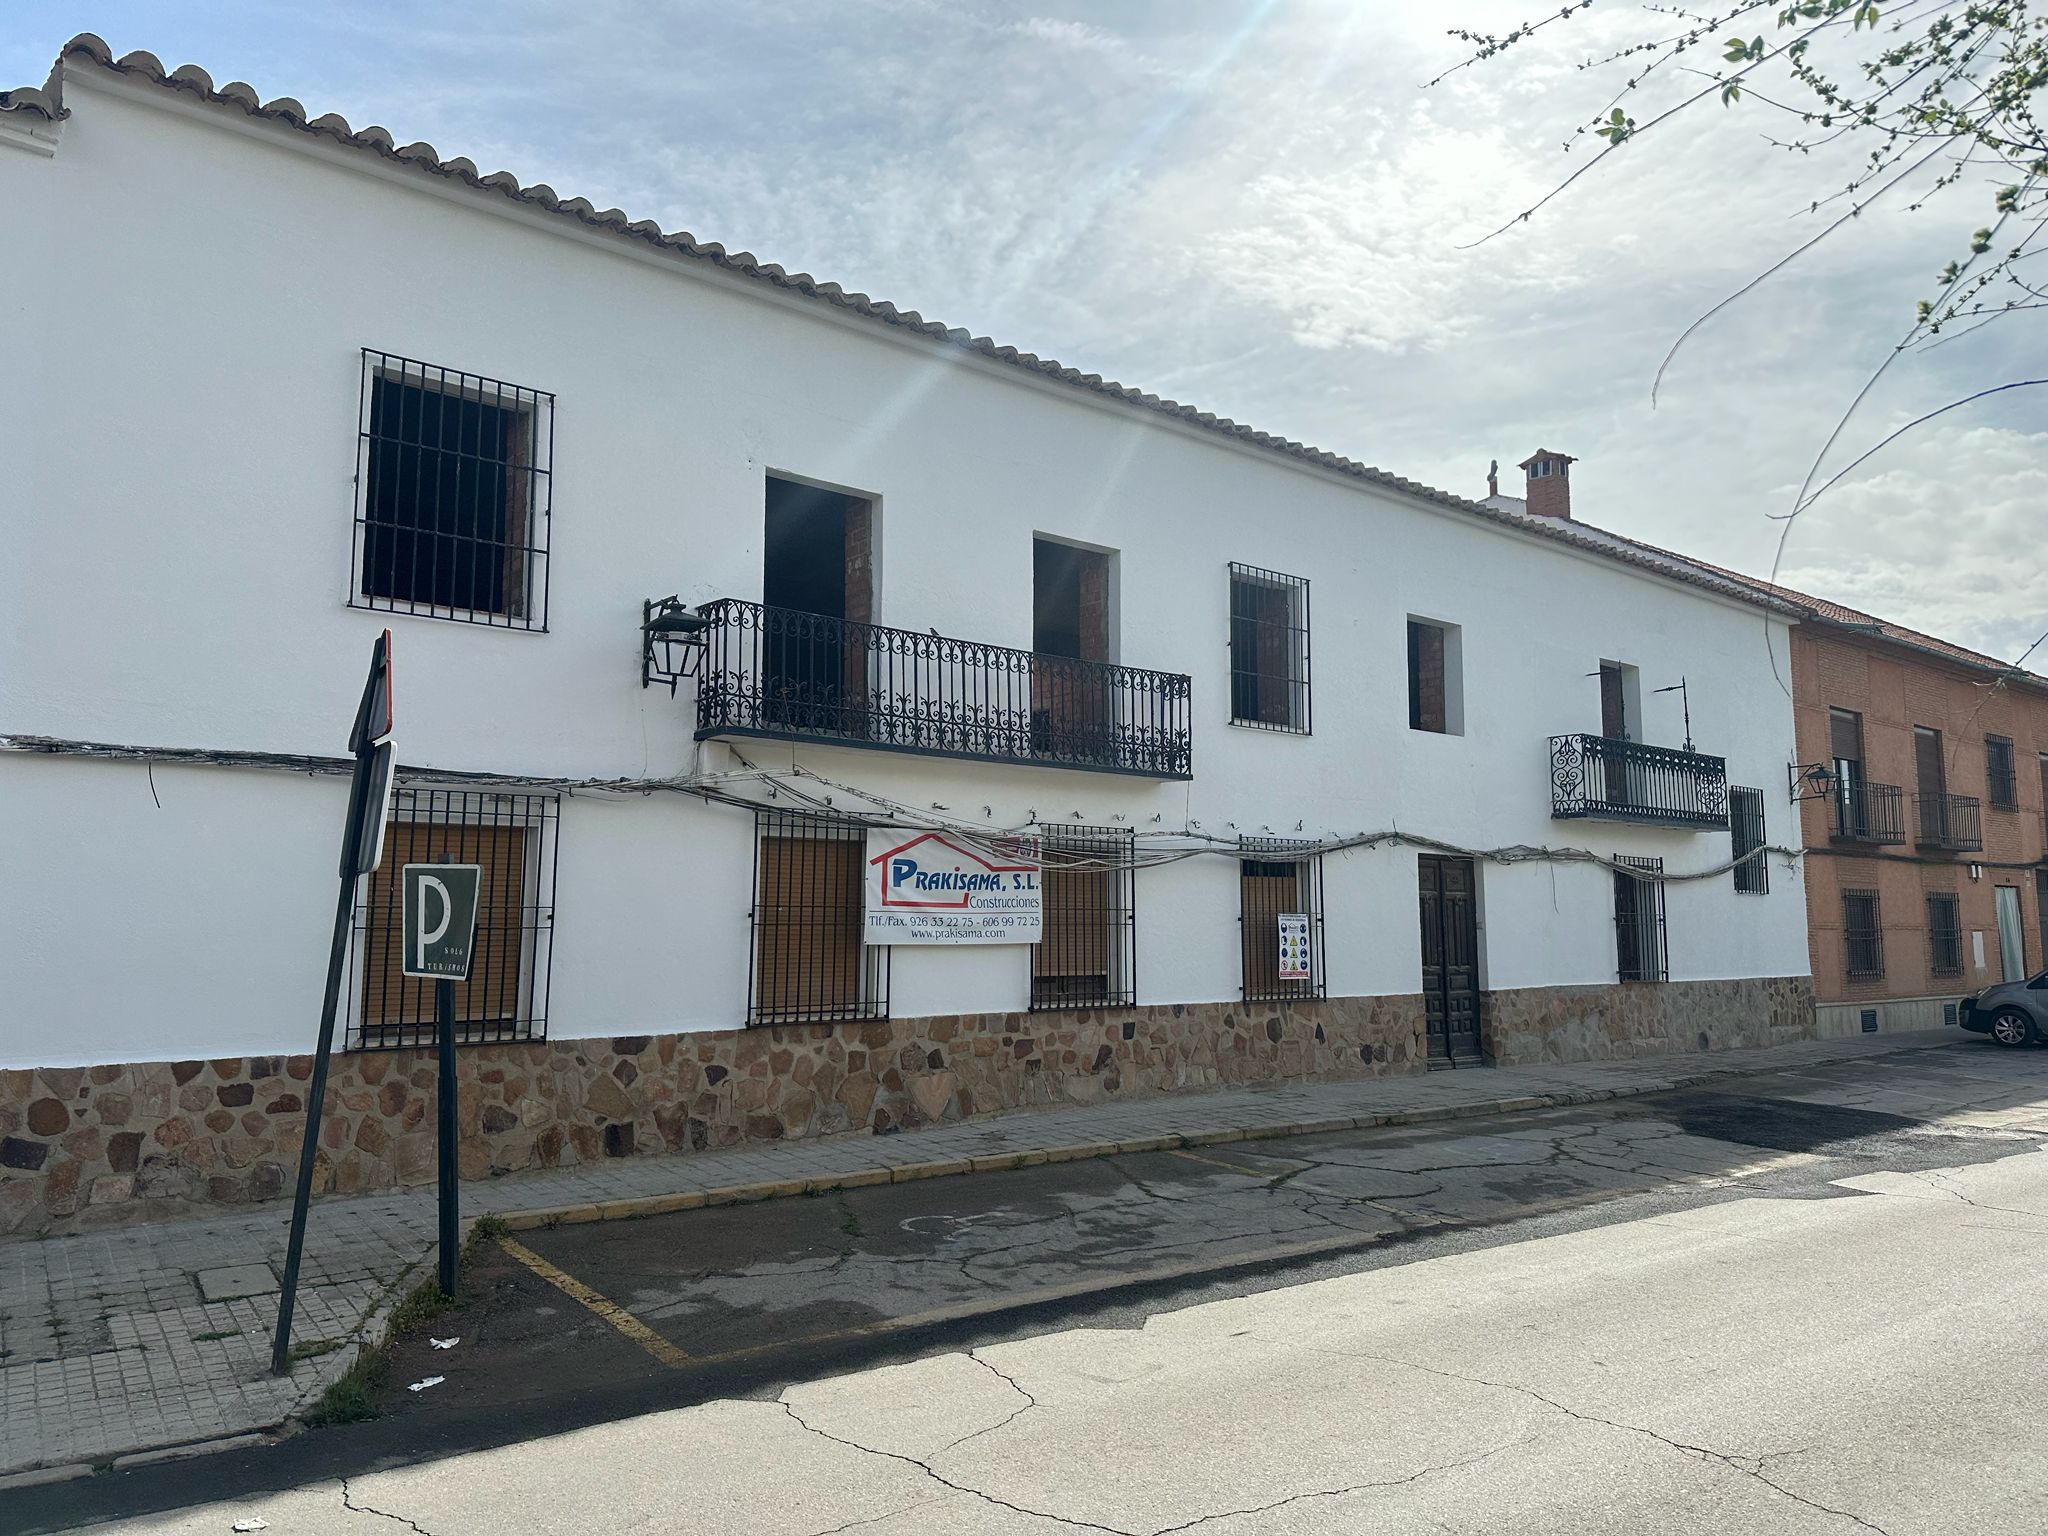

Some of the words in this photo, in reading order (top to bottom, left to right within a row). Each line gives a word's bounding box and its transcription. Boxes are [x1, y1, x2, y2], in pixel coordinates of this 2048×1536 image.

[1012, 873, 1039, 890] S.L.
[969, 895, 1040, 909] Construcciones
[418, 875, 451, 969] P
[869, 916, 907, 927] Tlf./Fax.
[910, 916, 928, 927] 926
[930, 917, 944, 927] 33
[946, 917, 959, 927] 22
[962, 917, 974, 927] 75
[982, 917, 1000, 927] 606
[1001, 917, 1014, 927] 99
[1017, 916, 1028, 926] 72
[1030, 916, 1040, 926] 25
[911, 928, 1006, 940] www.prakisama.com
